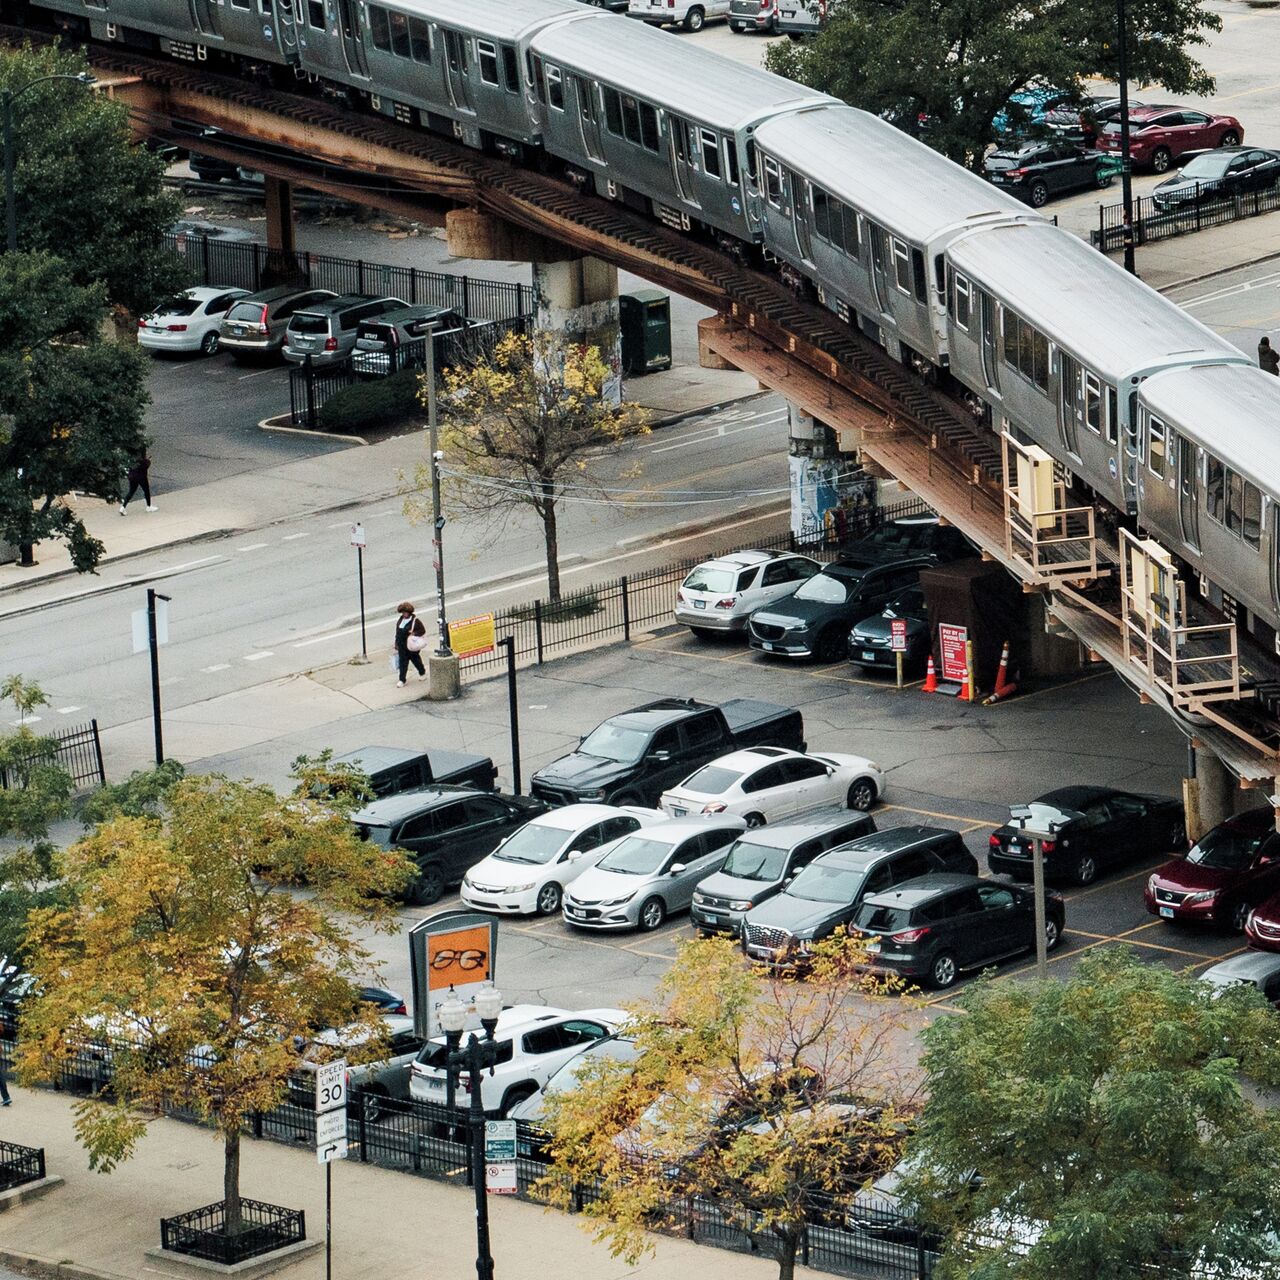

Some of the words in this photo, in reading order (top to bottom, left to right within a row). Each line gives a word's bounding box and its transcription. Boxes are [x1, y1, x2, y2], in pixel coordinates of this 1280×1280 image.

[319, 1064, 344, 1078] SPEED
[322, 1074, 340, 1086] LIMIT
[321, 1084, 342, 1105] 30
